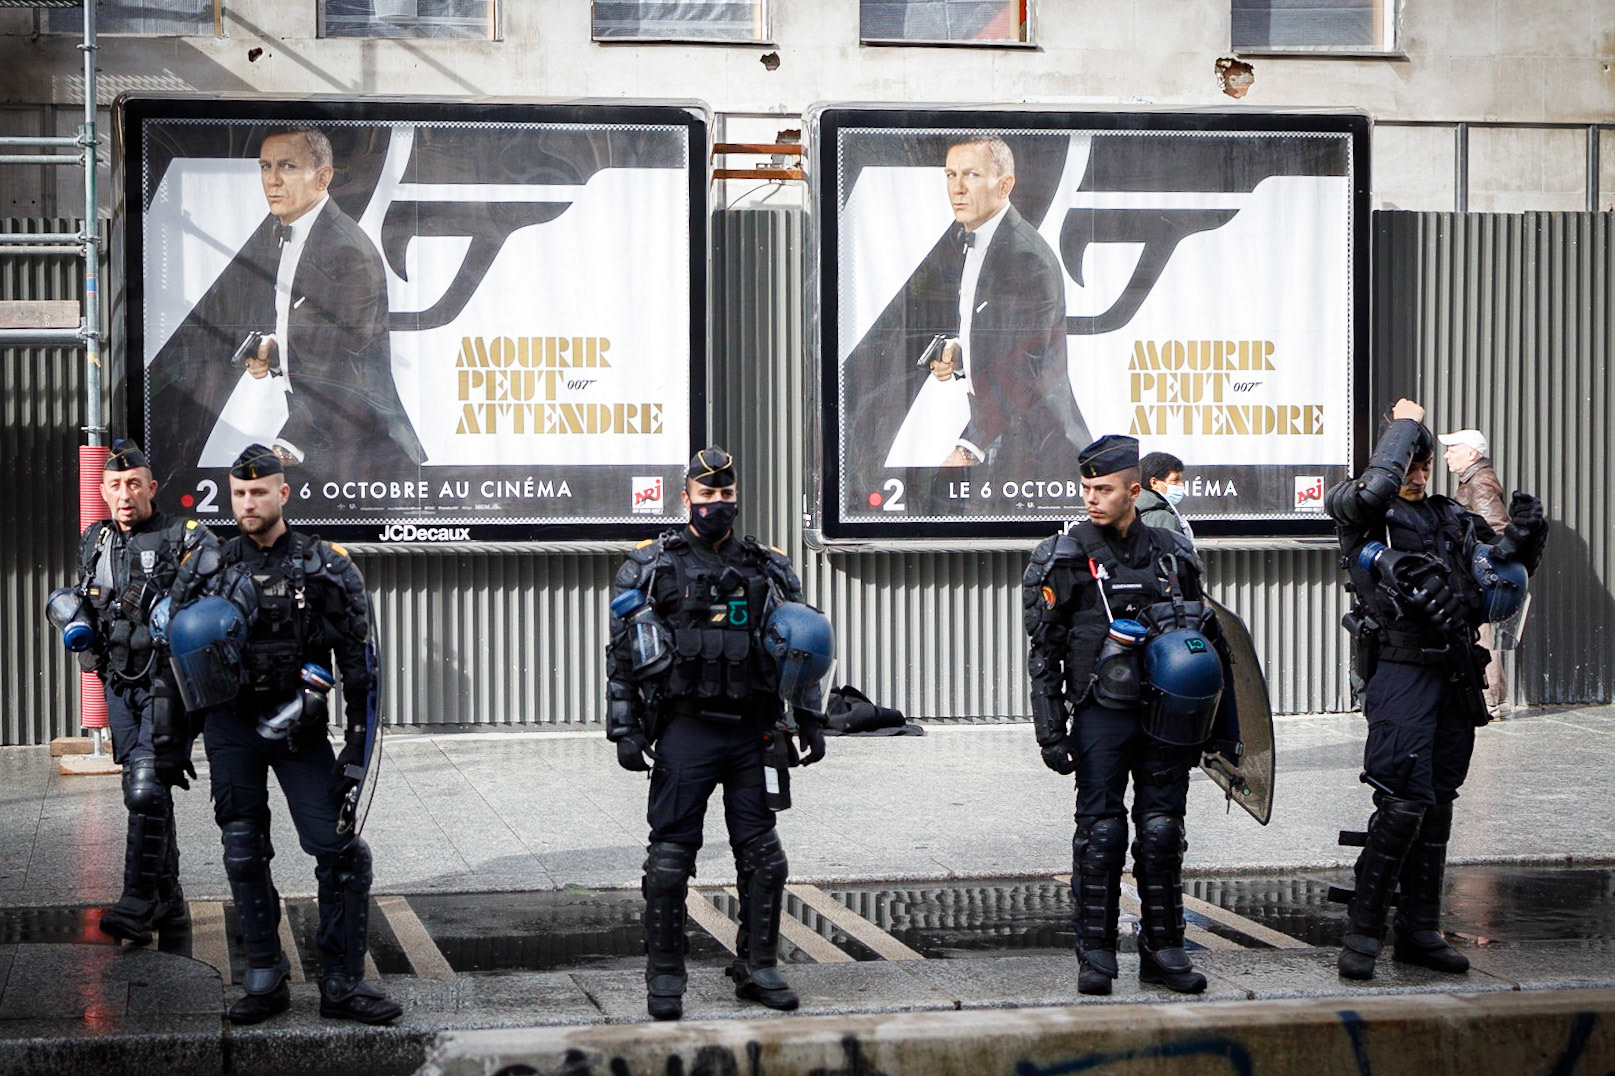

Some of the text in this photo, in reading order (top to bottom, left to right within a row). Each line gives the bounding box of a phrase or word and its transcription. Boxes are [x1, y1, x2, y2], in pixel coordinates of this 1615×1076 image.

[456, 336, 612, 368] MOURIR
[1128, 340, 1276, 370] MOURIR
[458, 370, 564, 401] PEUT
[567, 379, 597, 391] 007
[1130, 372, 1230, 403] PEUT
[1233, 381, 1262, 392] 007
[456, 403, 663, 434] ATTENDRE
[1129, 405, 1324, 435] ATTENDRE
[196, 479, 219, 513] 2
[300, 476, 572, 499] 6 OCTOBRE AU CINÉMA
[882, 478, 905, 511] 2
[949, 481, 970, 498] LE
[980, 481, 992, 498] 6
[1002, 481, 1084, 498] OCTOB
[379, 525, 470, 541] JCDecaux
